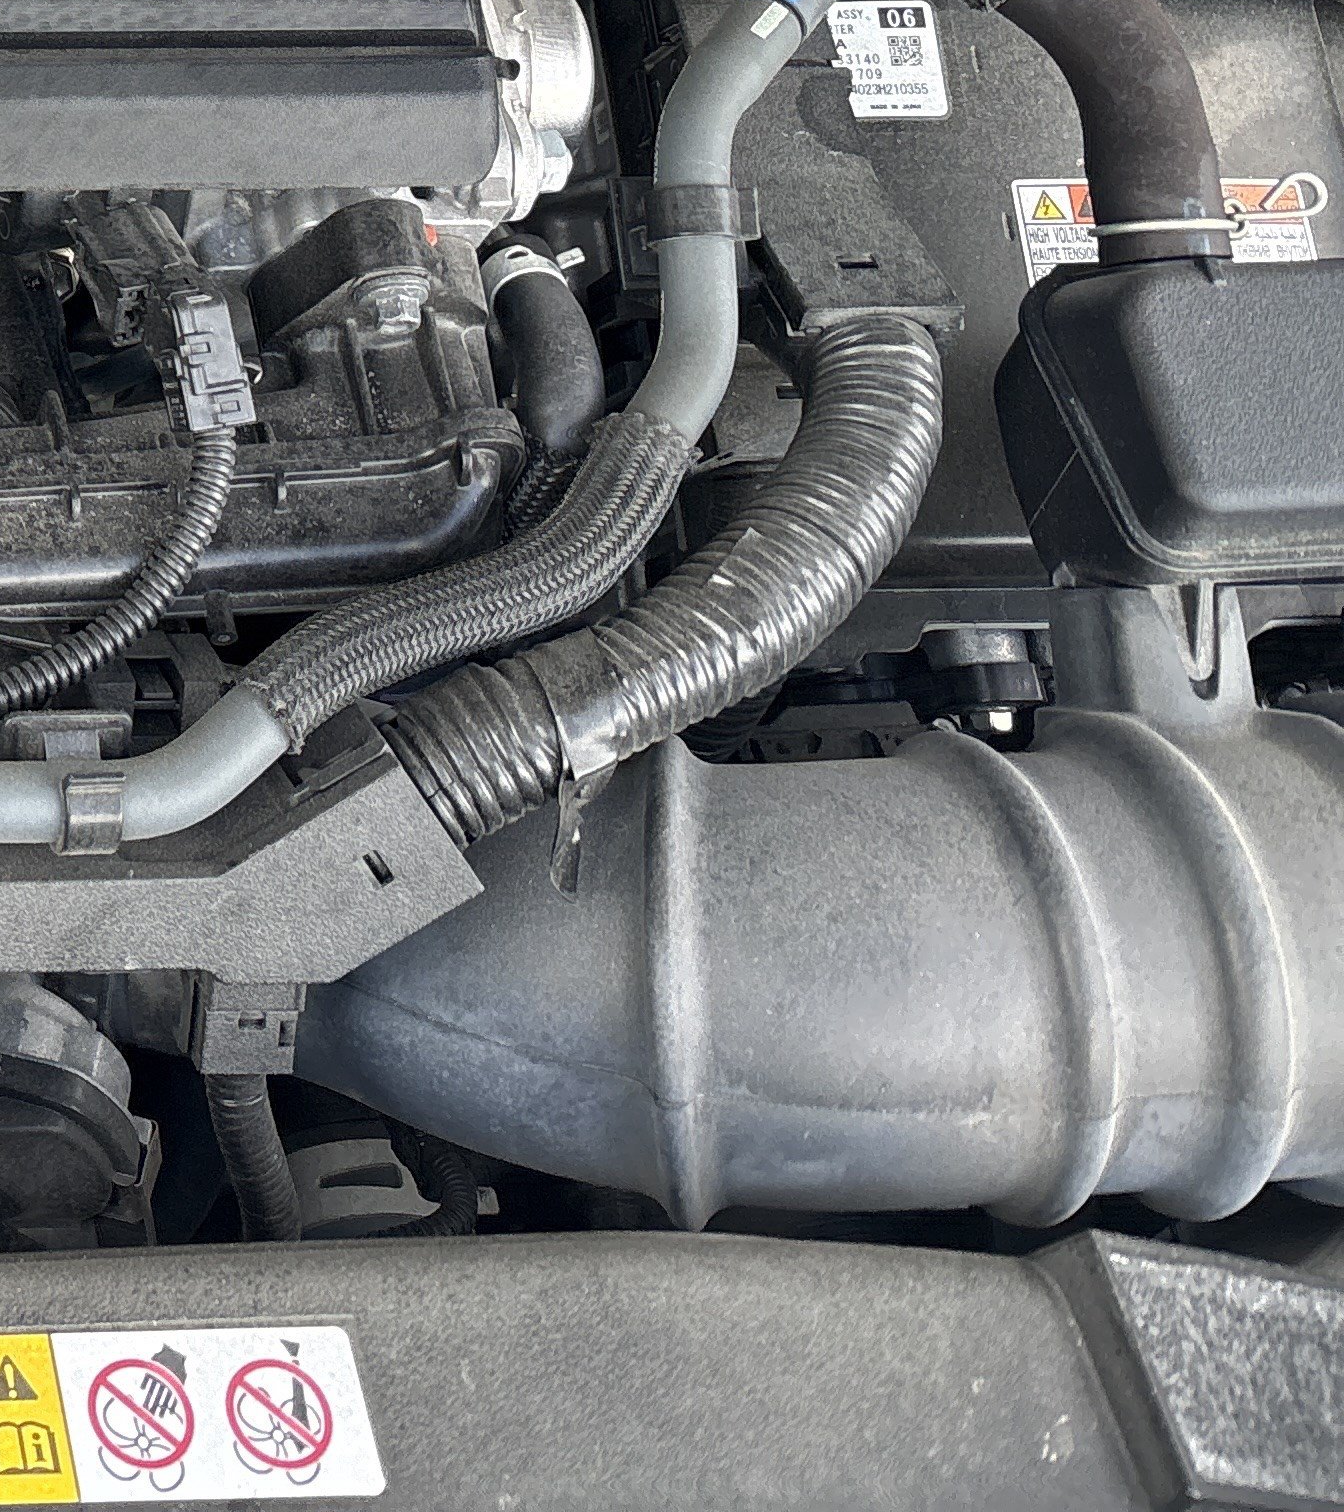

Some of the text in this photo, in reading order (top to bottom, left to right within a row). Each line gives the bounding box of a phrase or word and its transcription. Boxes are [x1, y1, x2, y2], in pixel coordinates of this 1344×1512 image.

[886, 9, 916, 28] 06
[1029, 227, 1050, 244] HIGH
[1032, 246, 1061, 261] HAUTE
